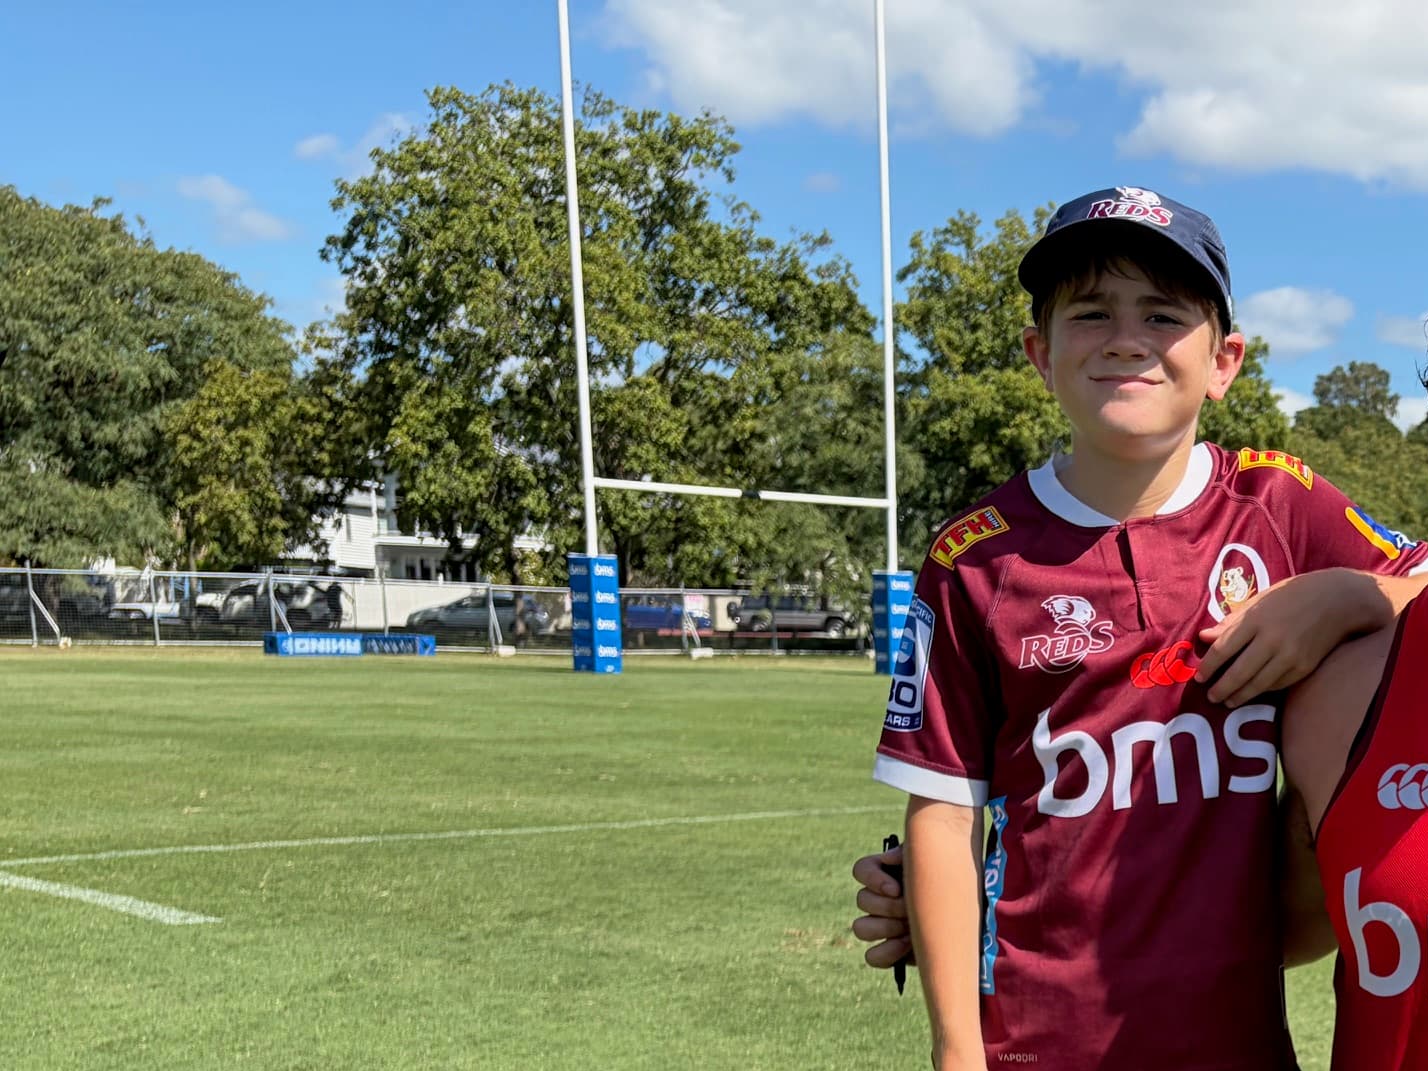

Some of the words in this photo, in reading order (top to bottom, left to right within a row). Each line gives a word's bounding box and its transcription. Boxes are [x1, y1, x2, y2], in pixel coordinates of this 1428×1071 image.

[1087, 199, 1173, 226] REDS
[933, 512, 995, 556] TFH
[1019, 621, 1115, 674] REDS
[1032, 704, 1277, 818] bms
